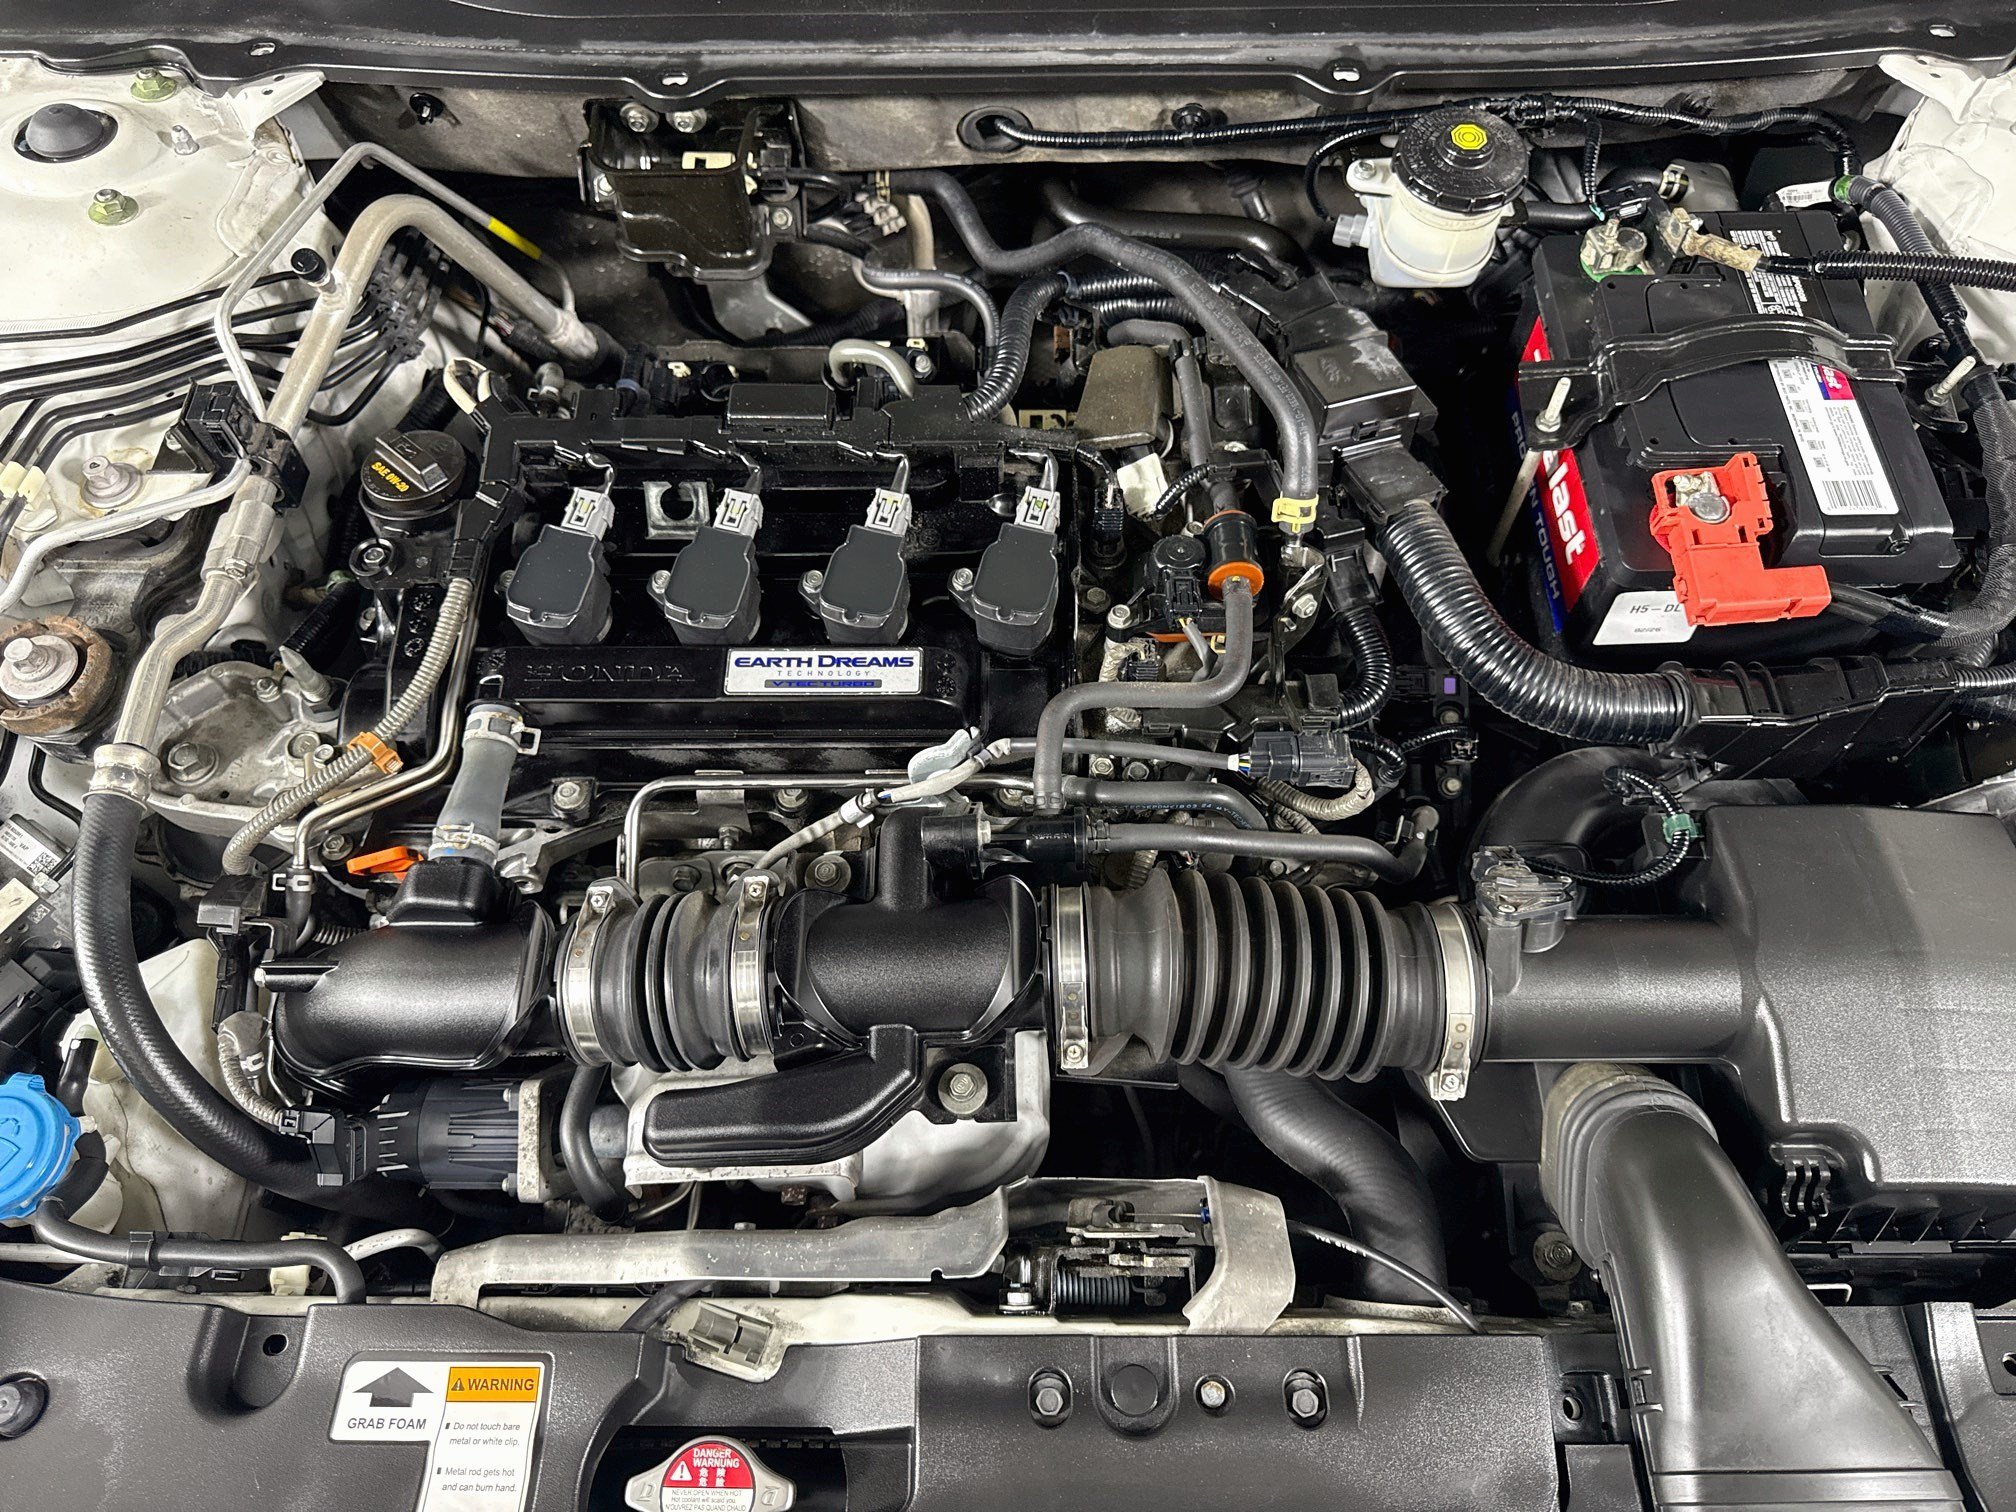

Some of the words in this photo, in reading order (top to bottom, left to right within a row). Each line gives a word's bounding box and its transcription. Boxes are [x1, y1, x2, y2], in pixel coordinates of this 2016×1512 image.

[371, 462, 391, 477] SAE
[1535, 511, 1560, 600] TOUGH
[734, 656, 813, 668] EARTH
[817, 654, 915, 668] DREAMS
[523, 664, 697, 682] HONDA
[821, 680, 875, 688] TURBO
[467, 1378, 535, 1391] WARNING
[347, 1417, 385, 1429] GRAB
[387, 1417, 427, 1429] FOAM
[453, 1422, 465, 1430] Do
[466, 1422, 479, 1430] not
[480, 1422, 501, 1430] touch
[502, 1422, 521, 1431] bare
[449, 1437, 471, 1445] metal
[482, 1437, 503, 1446] white
[504, 1437, 520, 1447] clip.
[692, 1448, 731, 1458] DANGER
[692, 1457, 740, 1468] WARNUNG
[445, 1467, 467, 1476] Metal
[468, 1467, 482, 1476] rod
[483, 1468, 500, 1478] gets
[501, 1468, 515, 1476] hot
[441, 1483, 458, 1491] and
[494, 1483, 517, 1492] hand.
